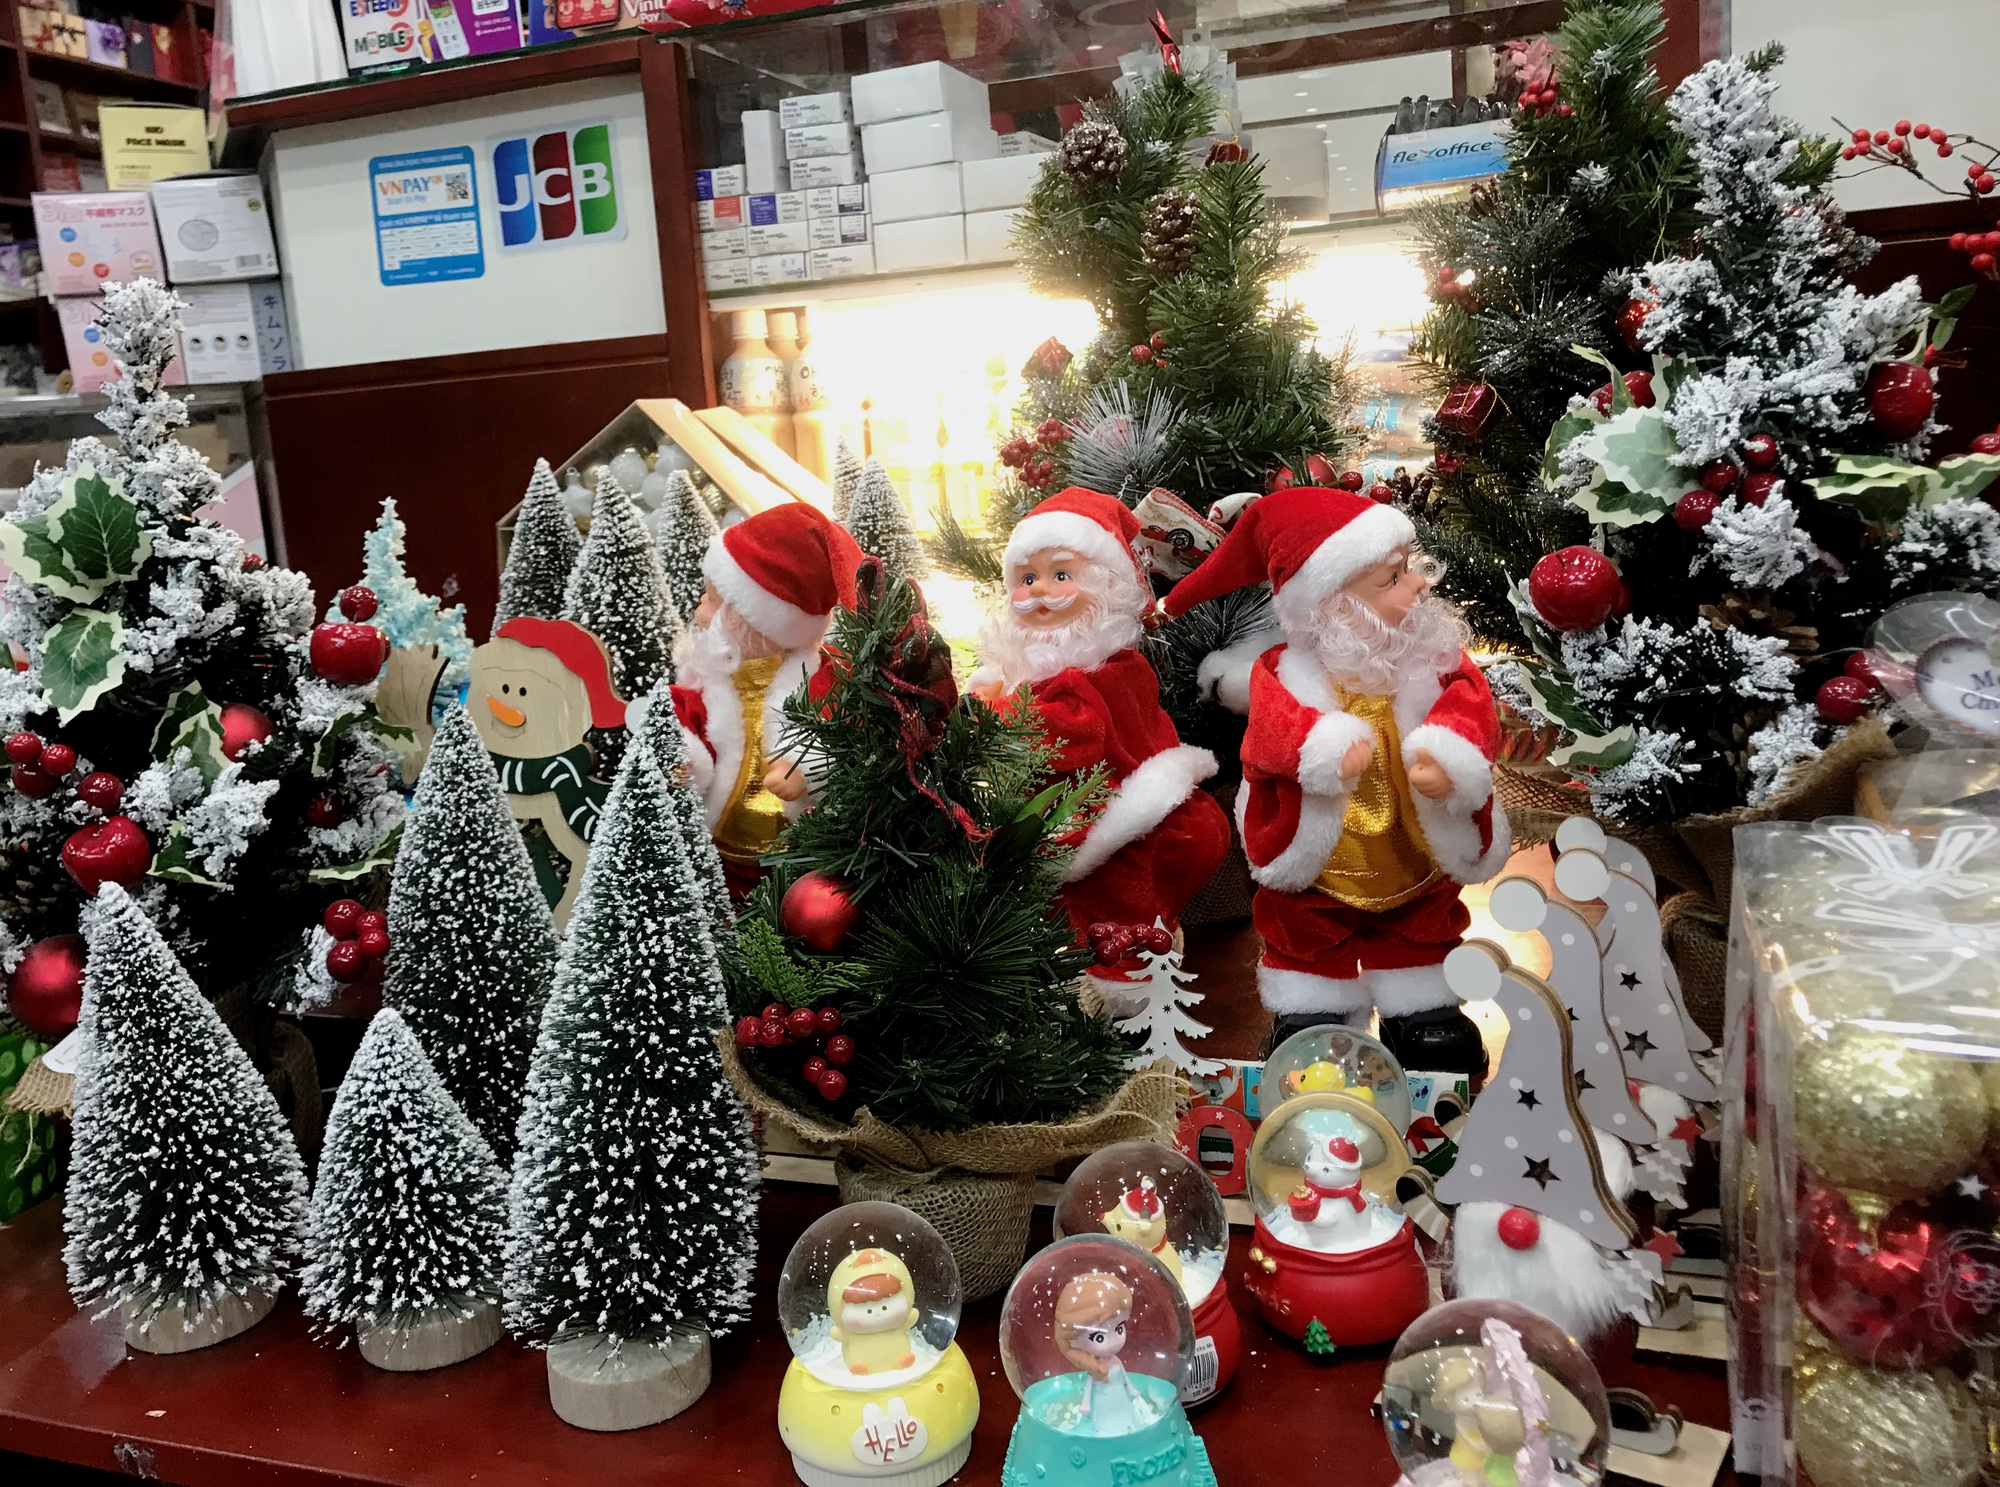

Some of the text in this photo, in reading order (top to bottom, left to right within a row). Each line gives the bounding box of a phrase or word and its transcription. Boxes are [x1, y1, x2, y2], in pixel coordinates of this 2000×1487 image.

[641, 12, 660, 23] Pay
[379, 177, 431, 196] VNPAY
[1968, 670, 2000, 690] M
[864, 1418, 917, 1462] HELLO
[1110, 1433, 1188, 1487] FROZEN
